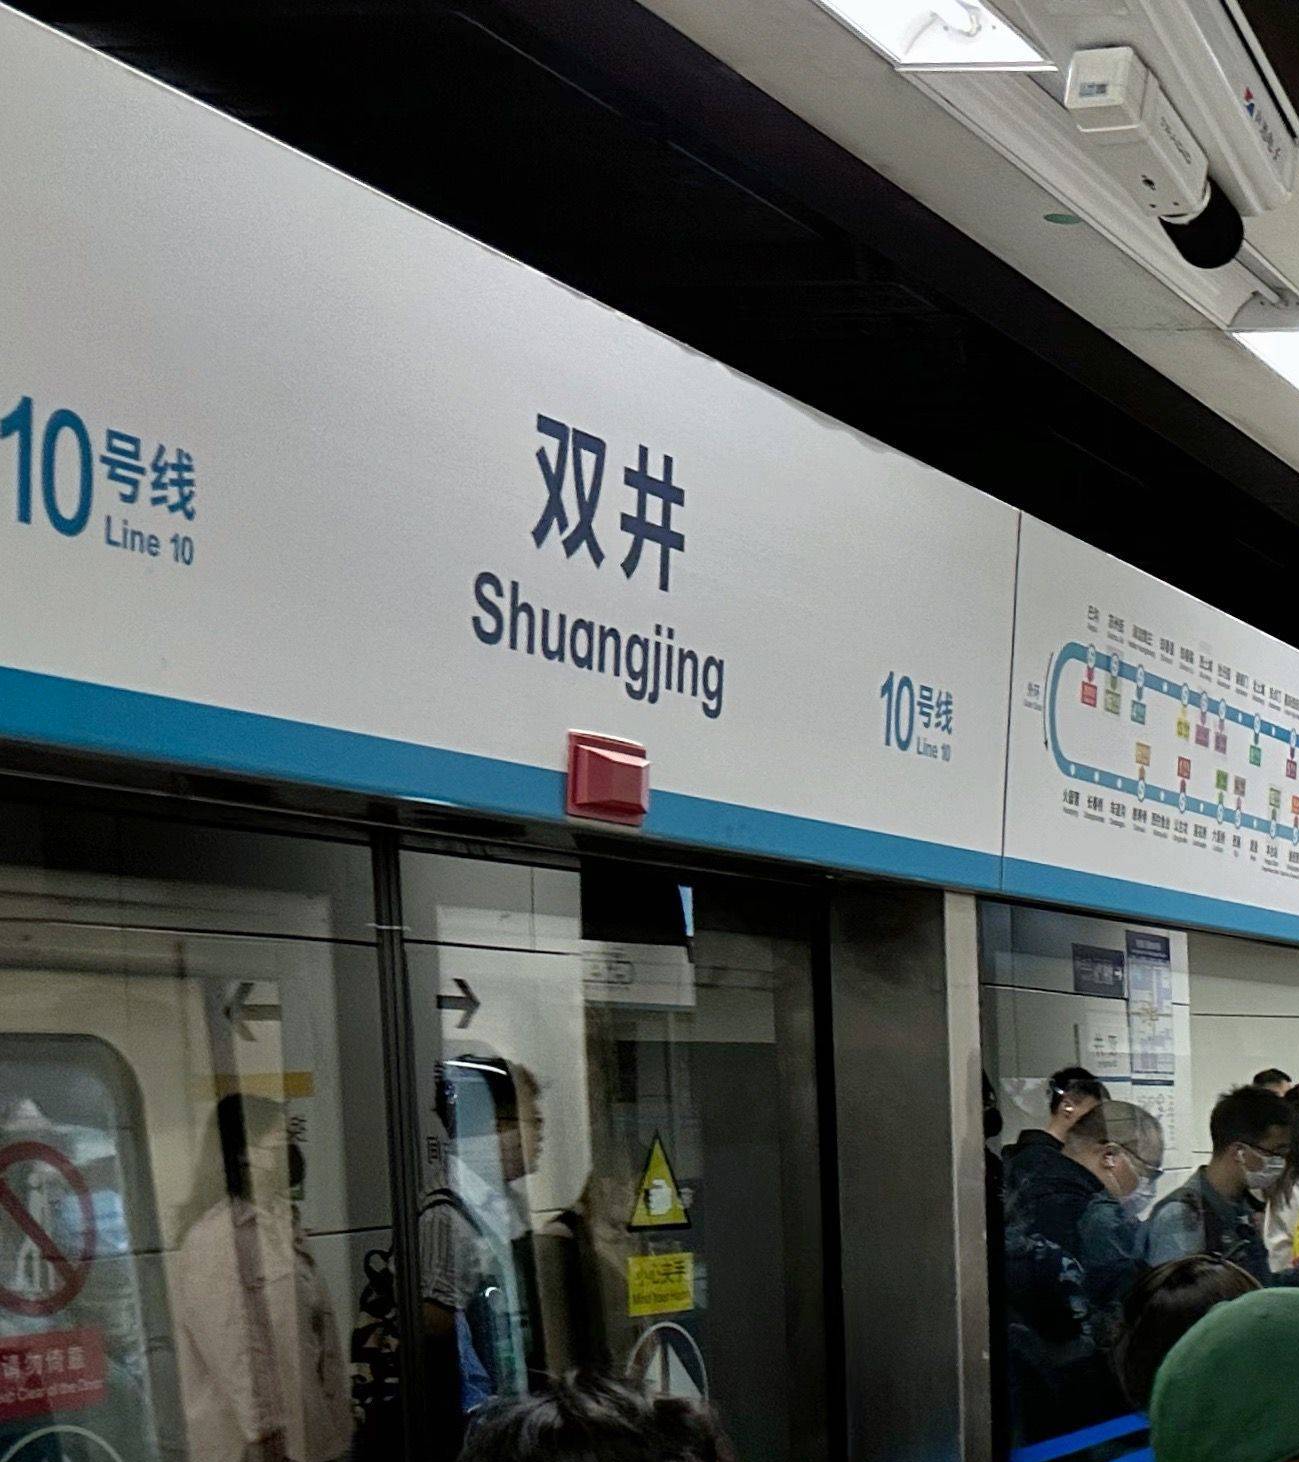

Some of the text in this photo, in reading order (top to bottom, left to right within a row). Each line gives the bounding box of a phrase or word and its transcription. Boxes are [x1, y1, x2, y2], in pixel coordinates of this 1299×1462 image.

[104, 514, 195, 566] Line 10
[530, 412, 686, 593] 双井
[471, 570, 725, 720] Shuangjing
[880, 670, 953, 752] 10号线
[917, 736, 951, 762] Line 10
